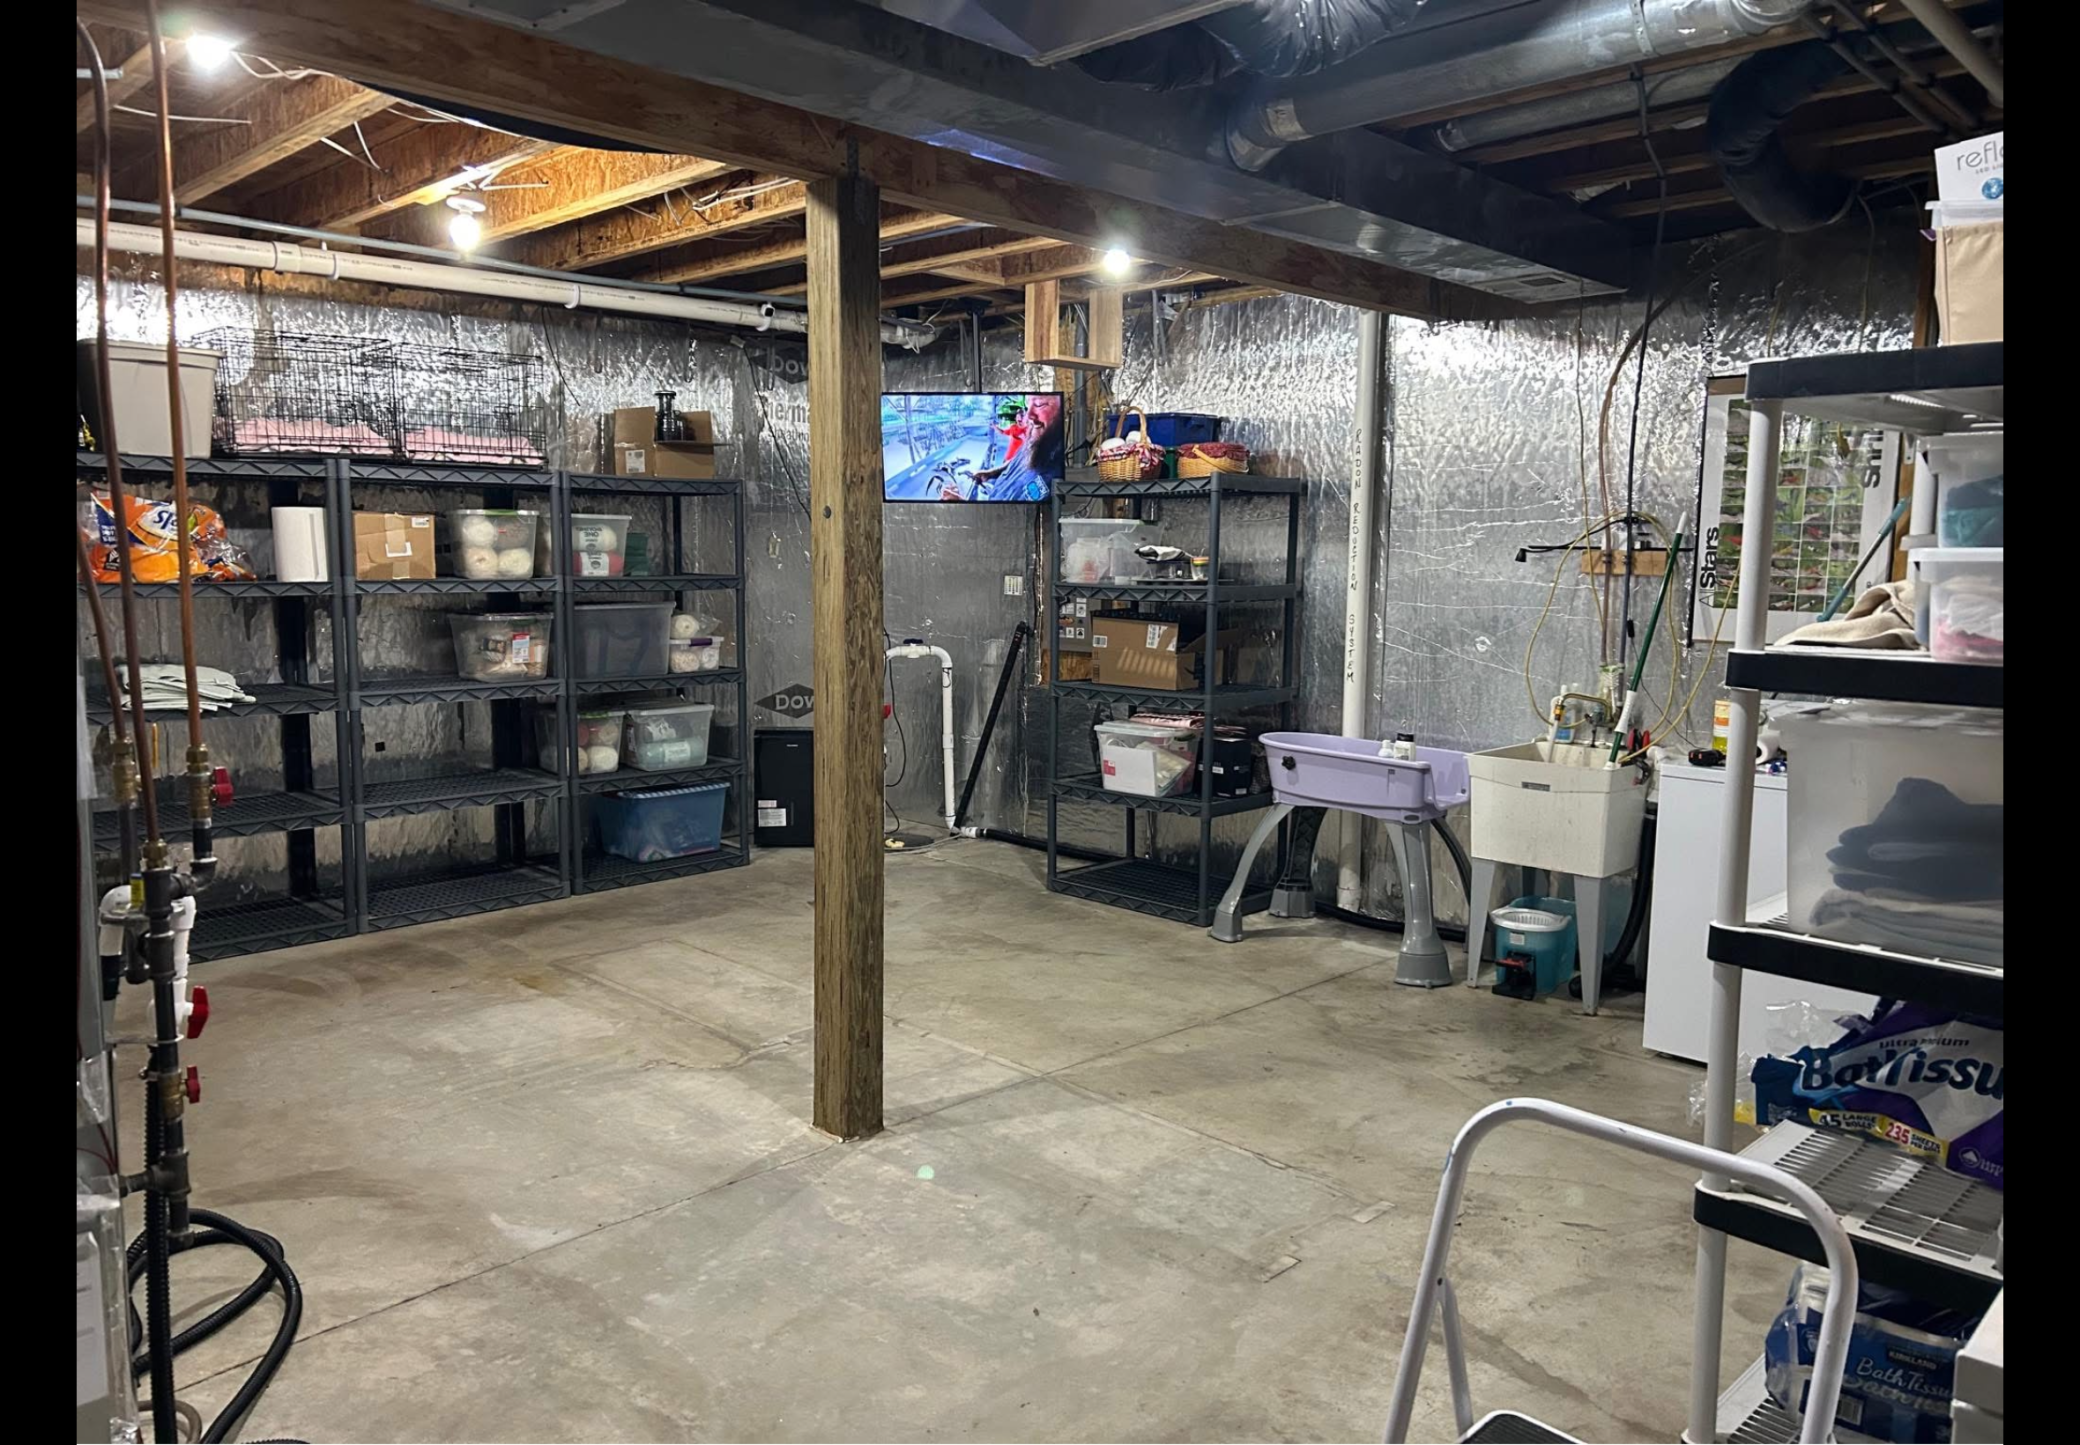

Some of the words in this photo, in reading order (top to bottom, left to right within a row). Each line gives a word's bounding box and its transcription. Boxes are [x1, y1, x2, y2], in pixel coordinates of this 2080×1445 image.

[1957, 140, 2003, 170] refl
[1353, 428, 1362, 489] RADON
[1346, 613, 1356, 683] SYSTEM
[1885, 1122, 1910, 1144] 235
[1856, 1357, 1907, 1387] Bath
